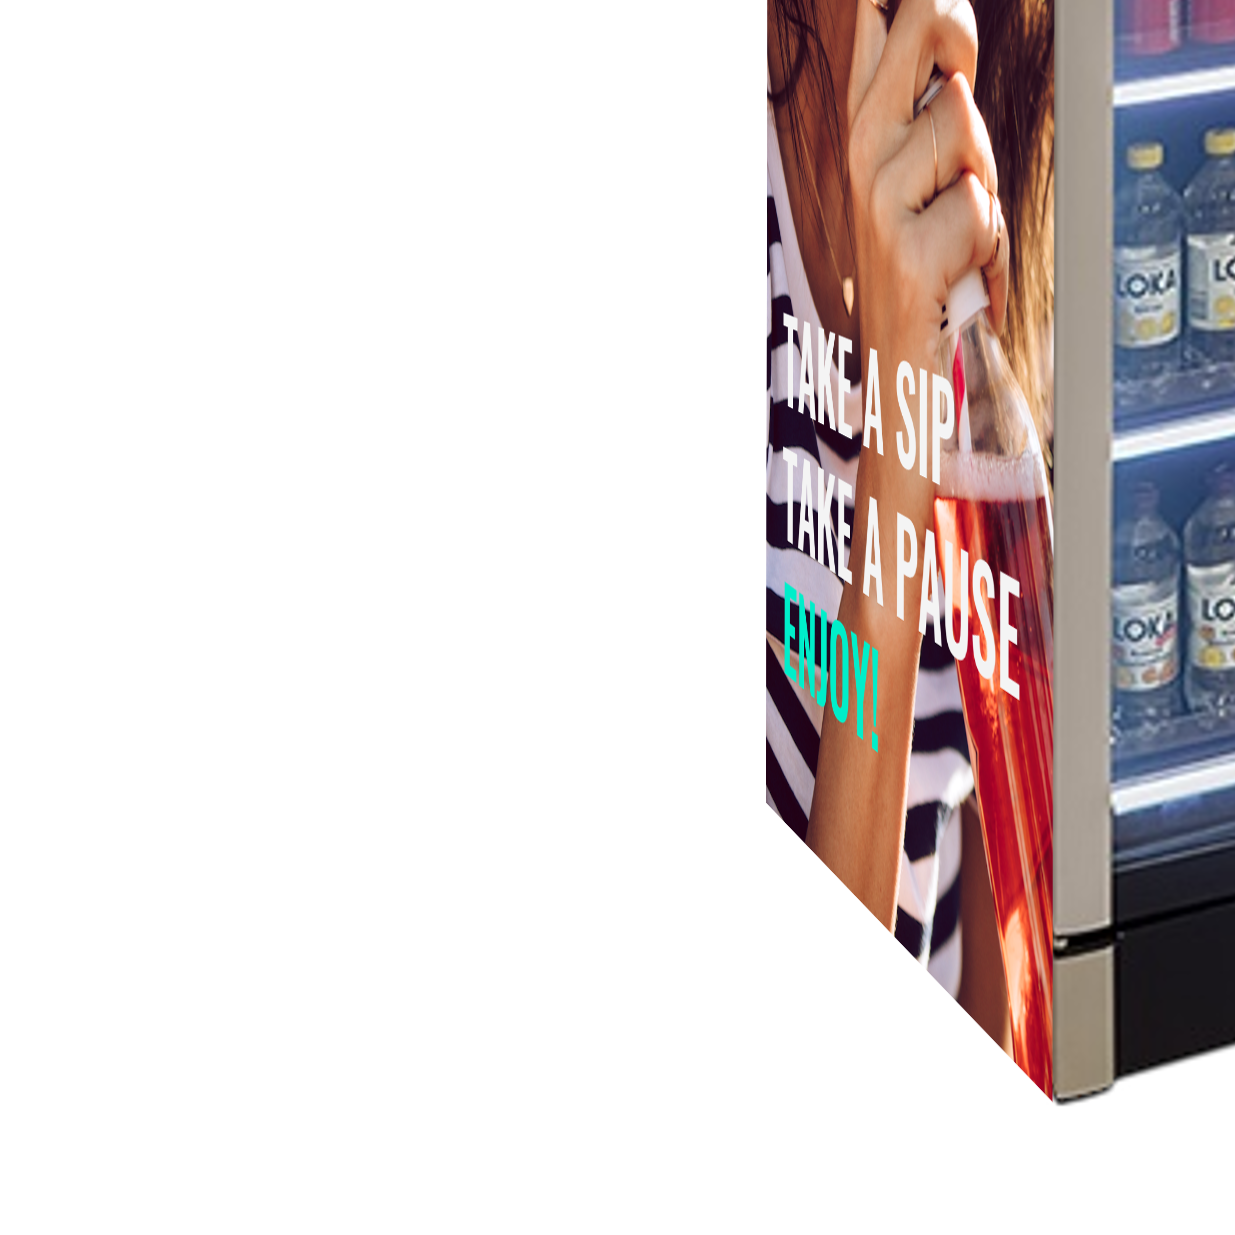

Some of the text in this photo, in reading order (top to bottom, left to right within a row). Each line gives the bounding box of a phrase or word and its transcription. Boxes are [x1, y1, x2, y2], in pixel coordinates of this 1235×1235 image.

[1116, 268, 1175, 299] LOKA
[783, 312, 955, 486] TAKE A SIP
[783, 446, 1021, 701] TAKE A PAUSE
[784, 581, 879, 753] ENJOY!
